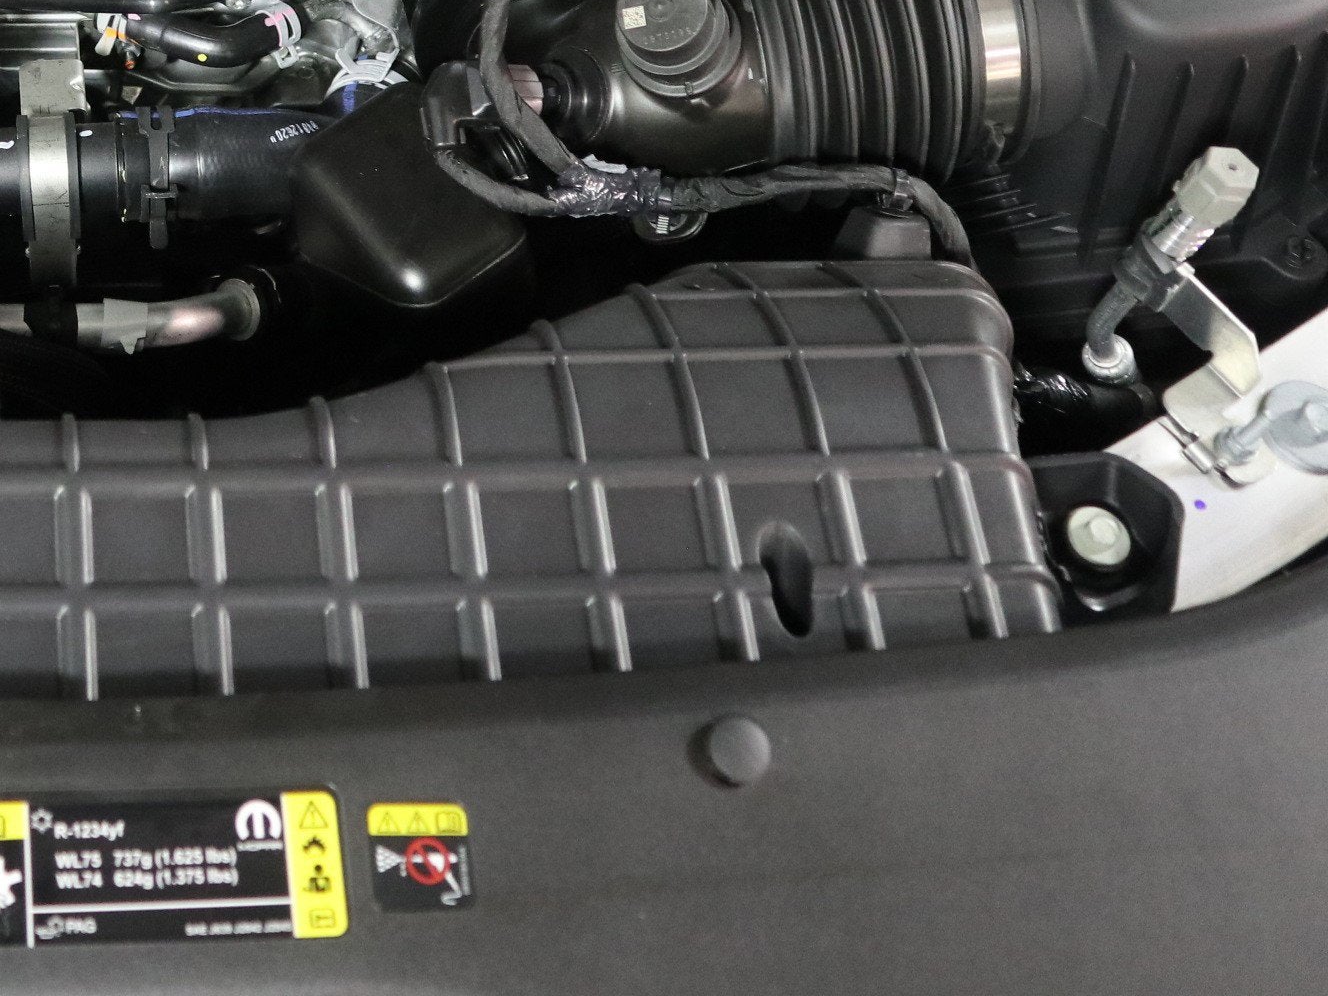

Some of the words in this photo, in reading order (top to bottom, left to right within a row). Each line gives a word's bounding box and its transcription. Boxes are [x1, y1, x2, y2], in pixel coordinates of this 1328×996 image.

[53, 819, 125, 841] R-1234yf
[54, 850, 103, 869] WL75
[112, 848, 153, 871] 737g
[204, 846, 238, 867] lbs)
[55, 870, 103, 890] WL74
[206, 866, 239, 887] lbs)
[65, 916, 97, 934] PAG
